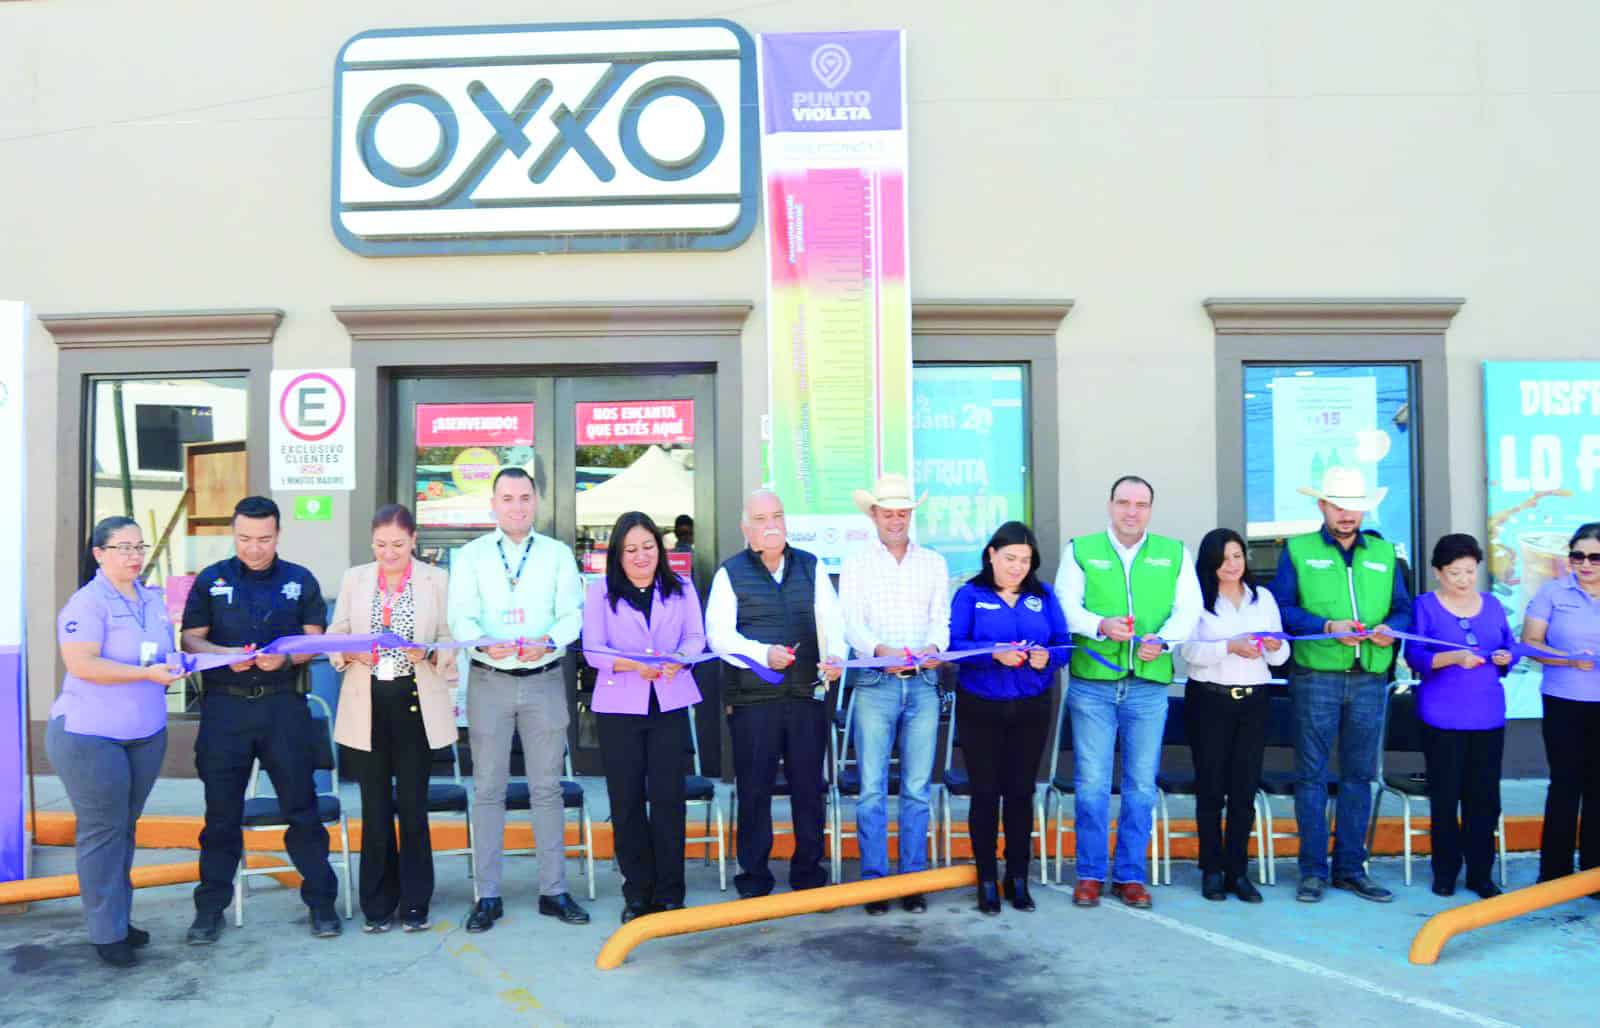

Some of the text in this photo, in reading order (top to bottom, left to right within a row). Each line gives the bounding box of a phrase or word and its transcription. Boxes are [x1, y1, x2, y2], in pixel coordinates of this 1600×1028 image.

[792, 90, 871, 107] PUNTO
[792, 107, 872, 121] VIOLETA
[356, 68, 725, 200] OXXO
[299, 388, 326, 426] E
[621, 404, 676, 419] ENCANTA
[587, 423, 612, 440] QUE
[280, 444, 344, 454] EXCLUSIVO
[285, 454, 339, 464] CLIENTES
[1500, 435, 1562, 491] LO
